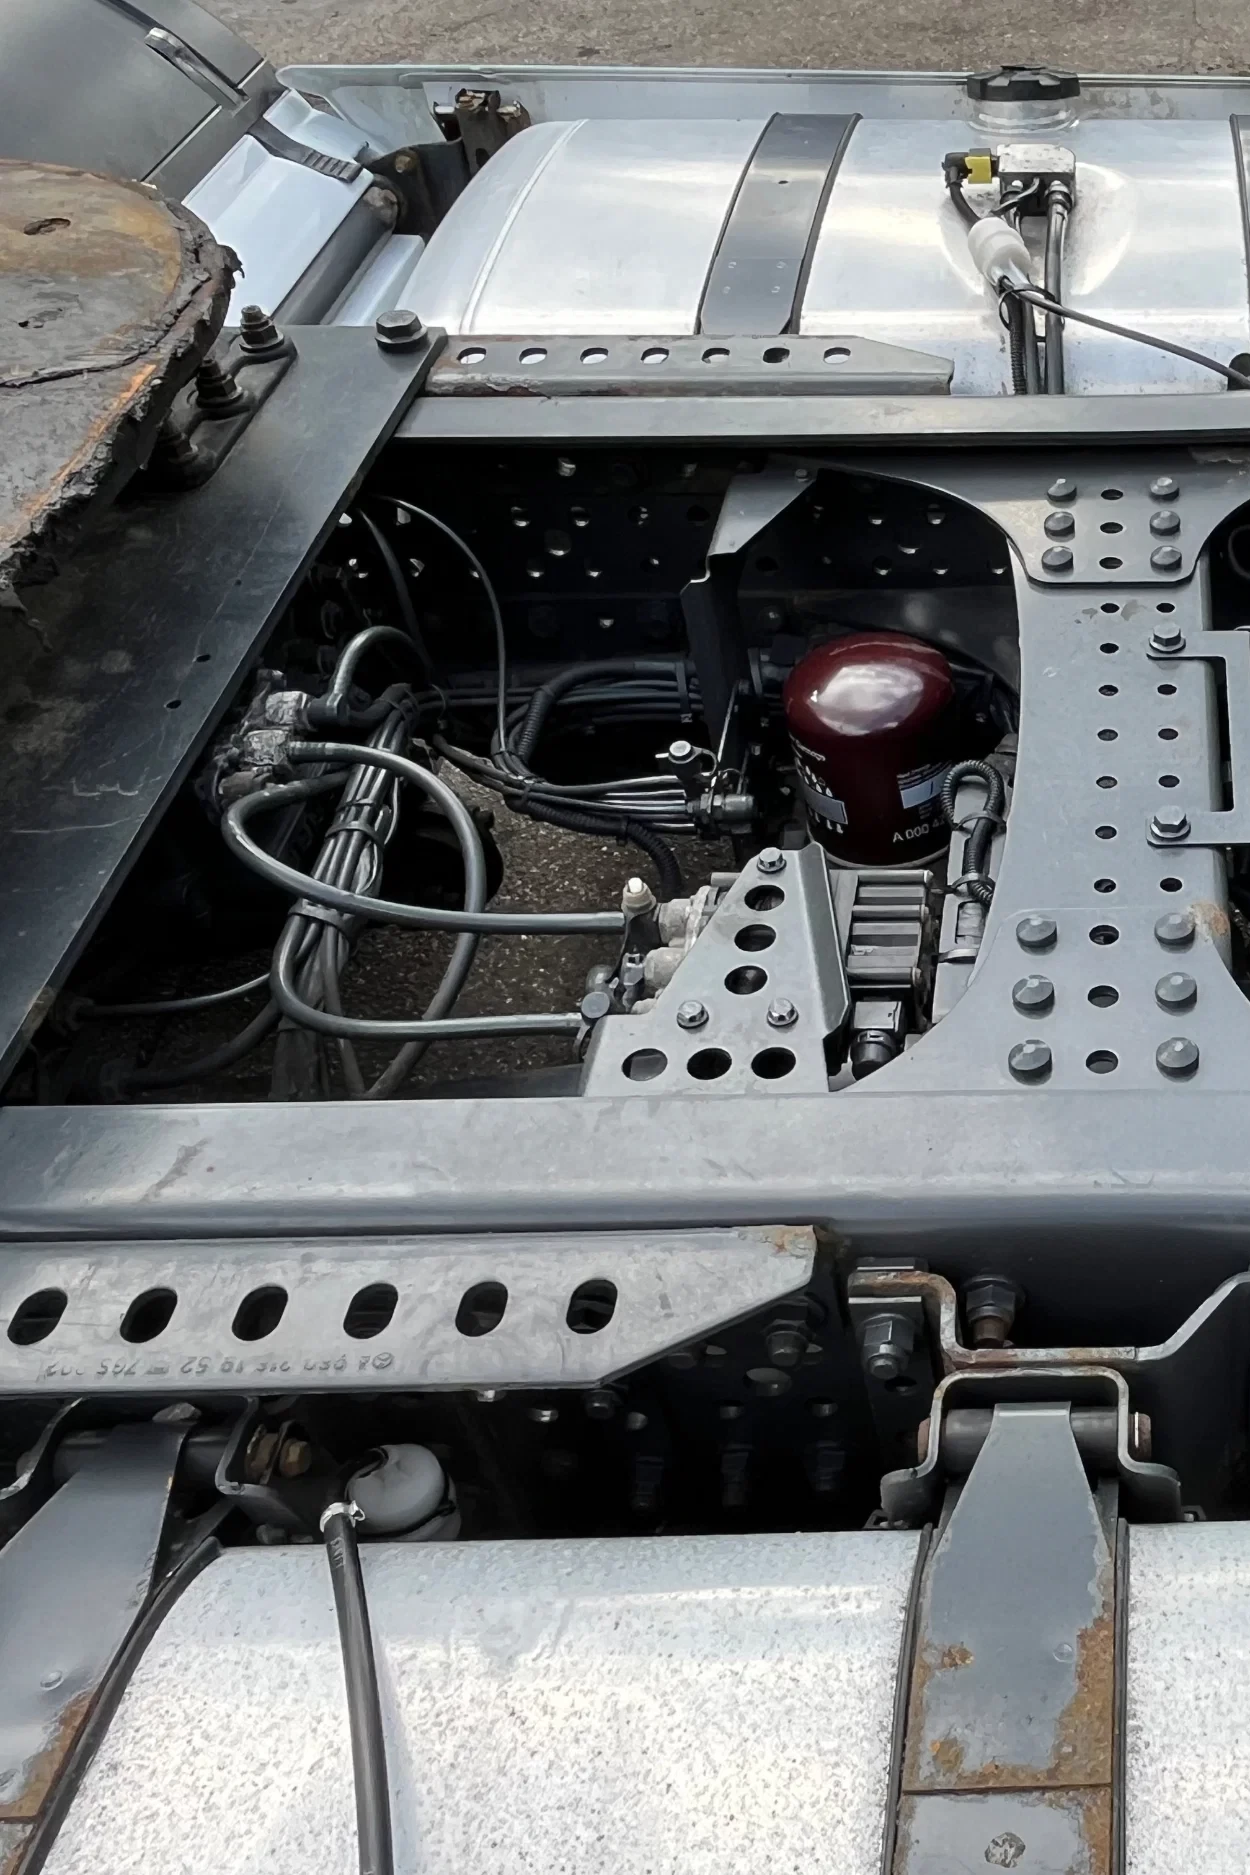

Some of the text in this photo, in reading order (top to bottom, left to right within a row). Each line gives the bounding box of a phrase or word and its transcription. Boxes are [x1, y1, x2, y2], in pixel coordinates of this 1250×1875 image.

[892, 831, 905, 843] A
[905, 823, 930, 840] 000
[180, 1356, 213, 1378] 52
